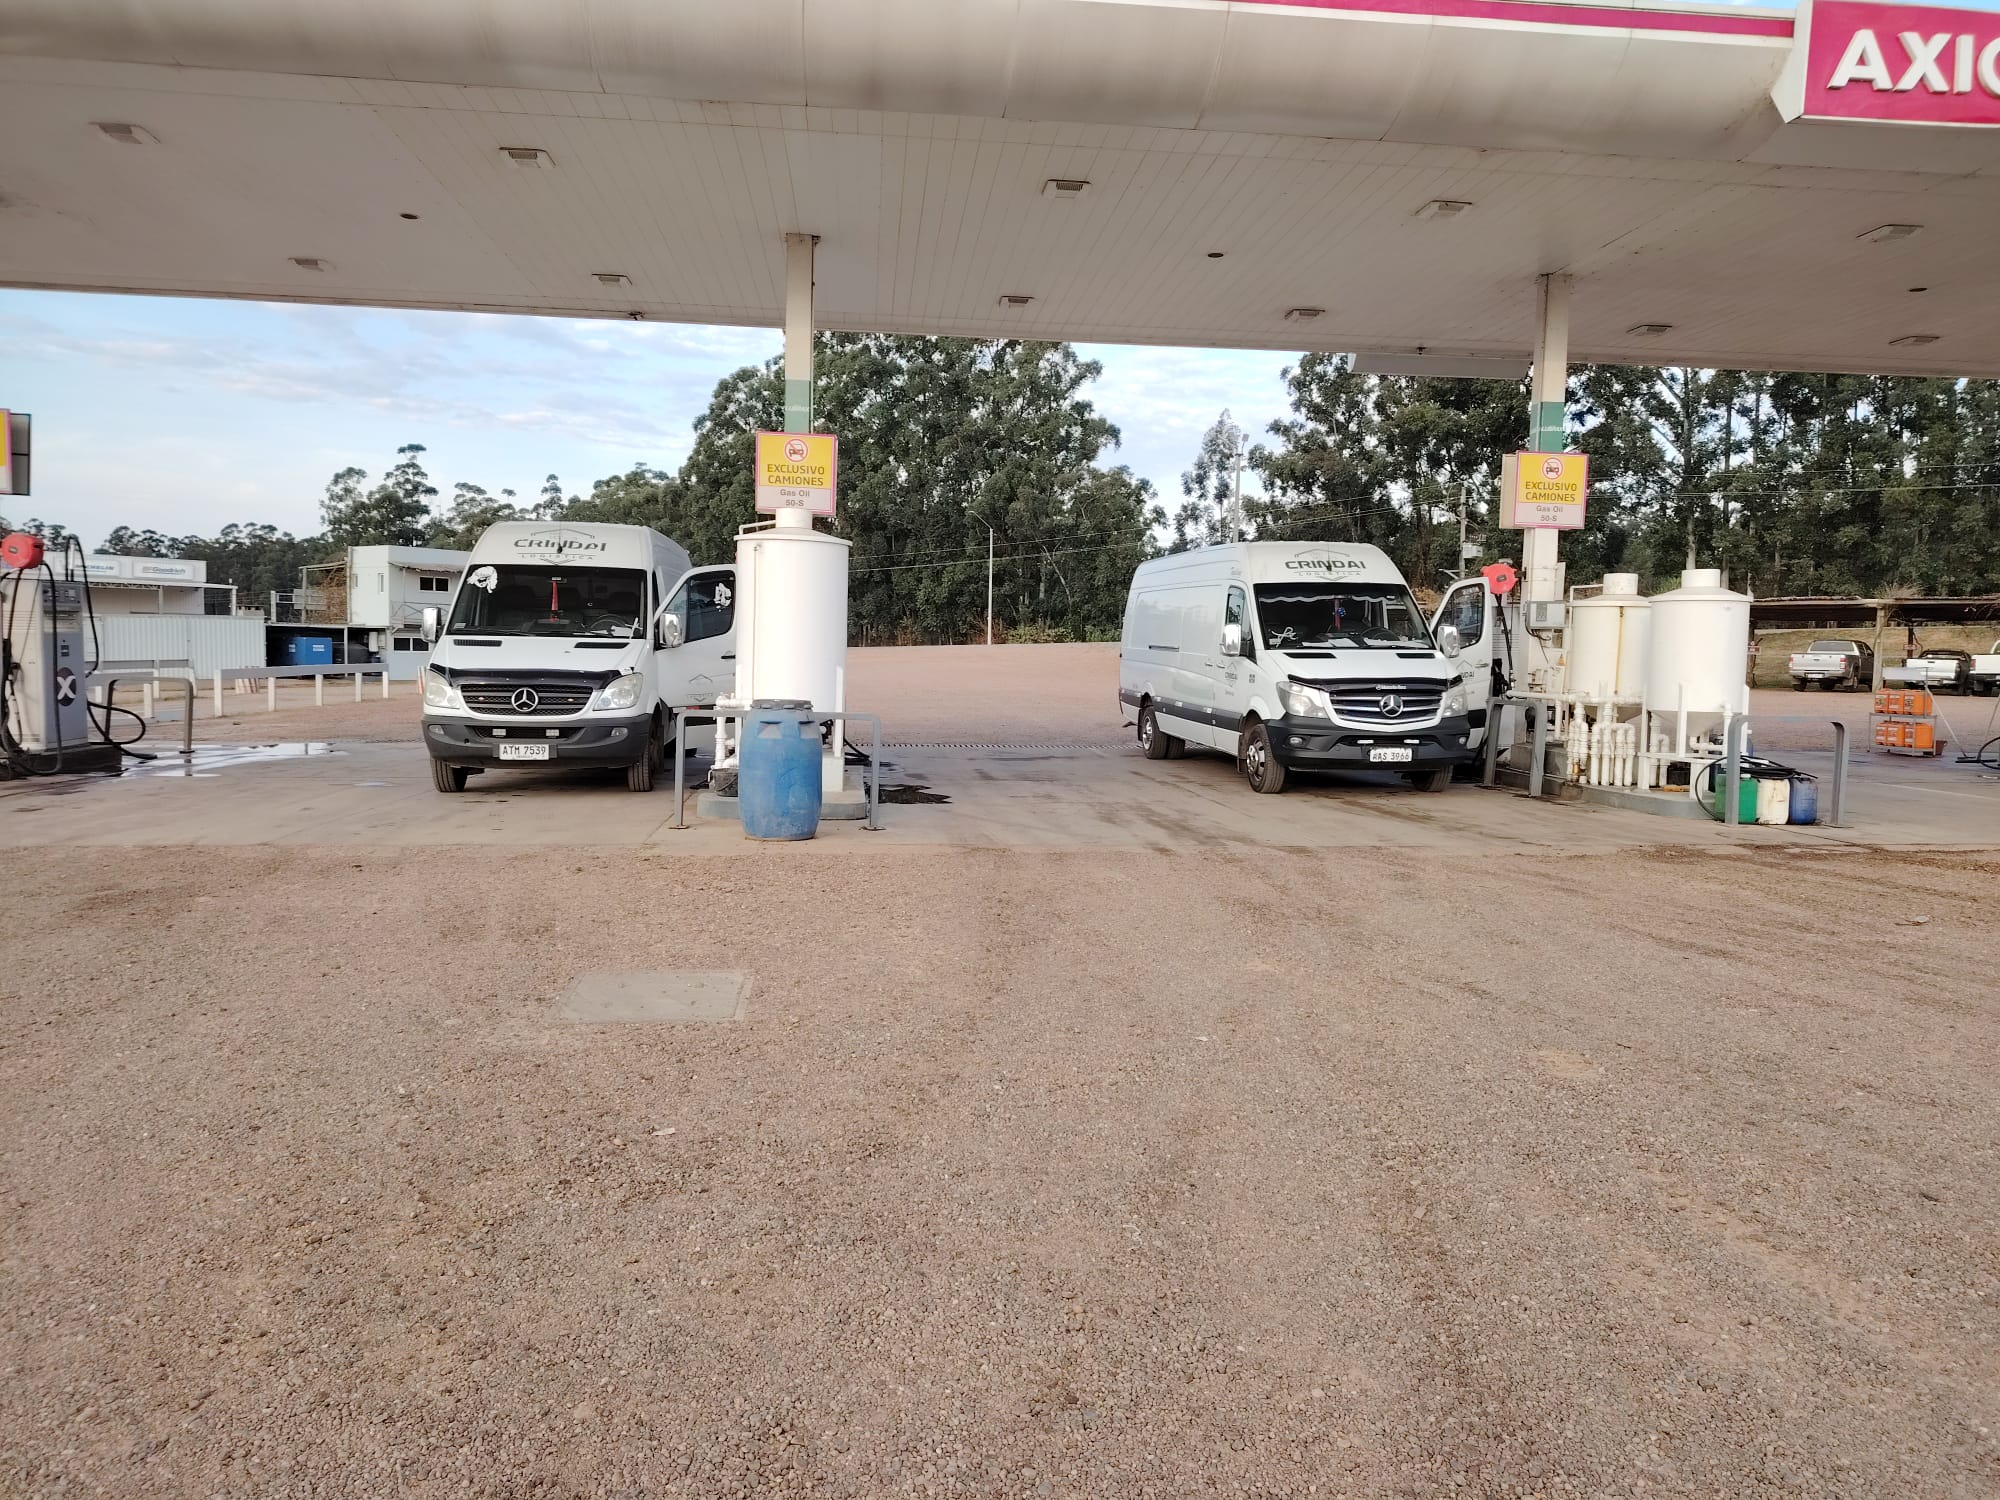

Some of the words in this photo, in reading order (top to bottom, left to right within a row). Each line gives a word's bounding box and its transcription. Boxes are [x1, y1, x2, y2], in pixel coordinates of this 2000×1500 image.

[767, 464, 825, 475] EXCLUSIVO
[768, 475, 824, 486] CAMIONES
[1525, 481, 1577, 491] EXCLUSIVO
[780, 489, 795, 497] Gas
[1525, 492, 1576, 502] CAMIONES
[785, 499, 804, 507] 50-S
[514, 539, 607, 552] CRINDAI
[1285, 560, 1366, 569] CRINDAI
[523, 746, 546, 755] 7539
[1390, 752, 1410, 761] 3966
